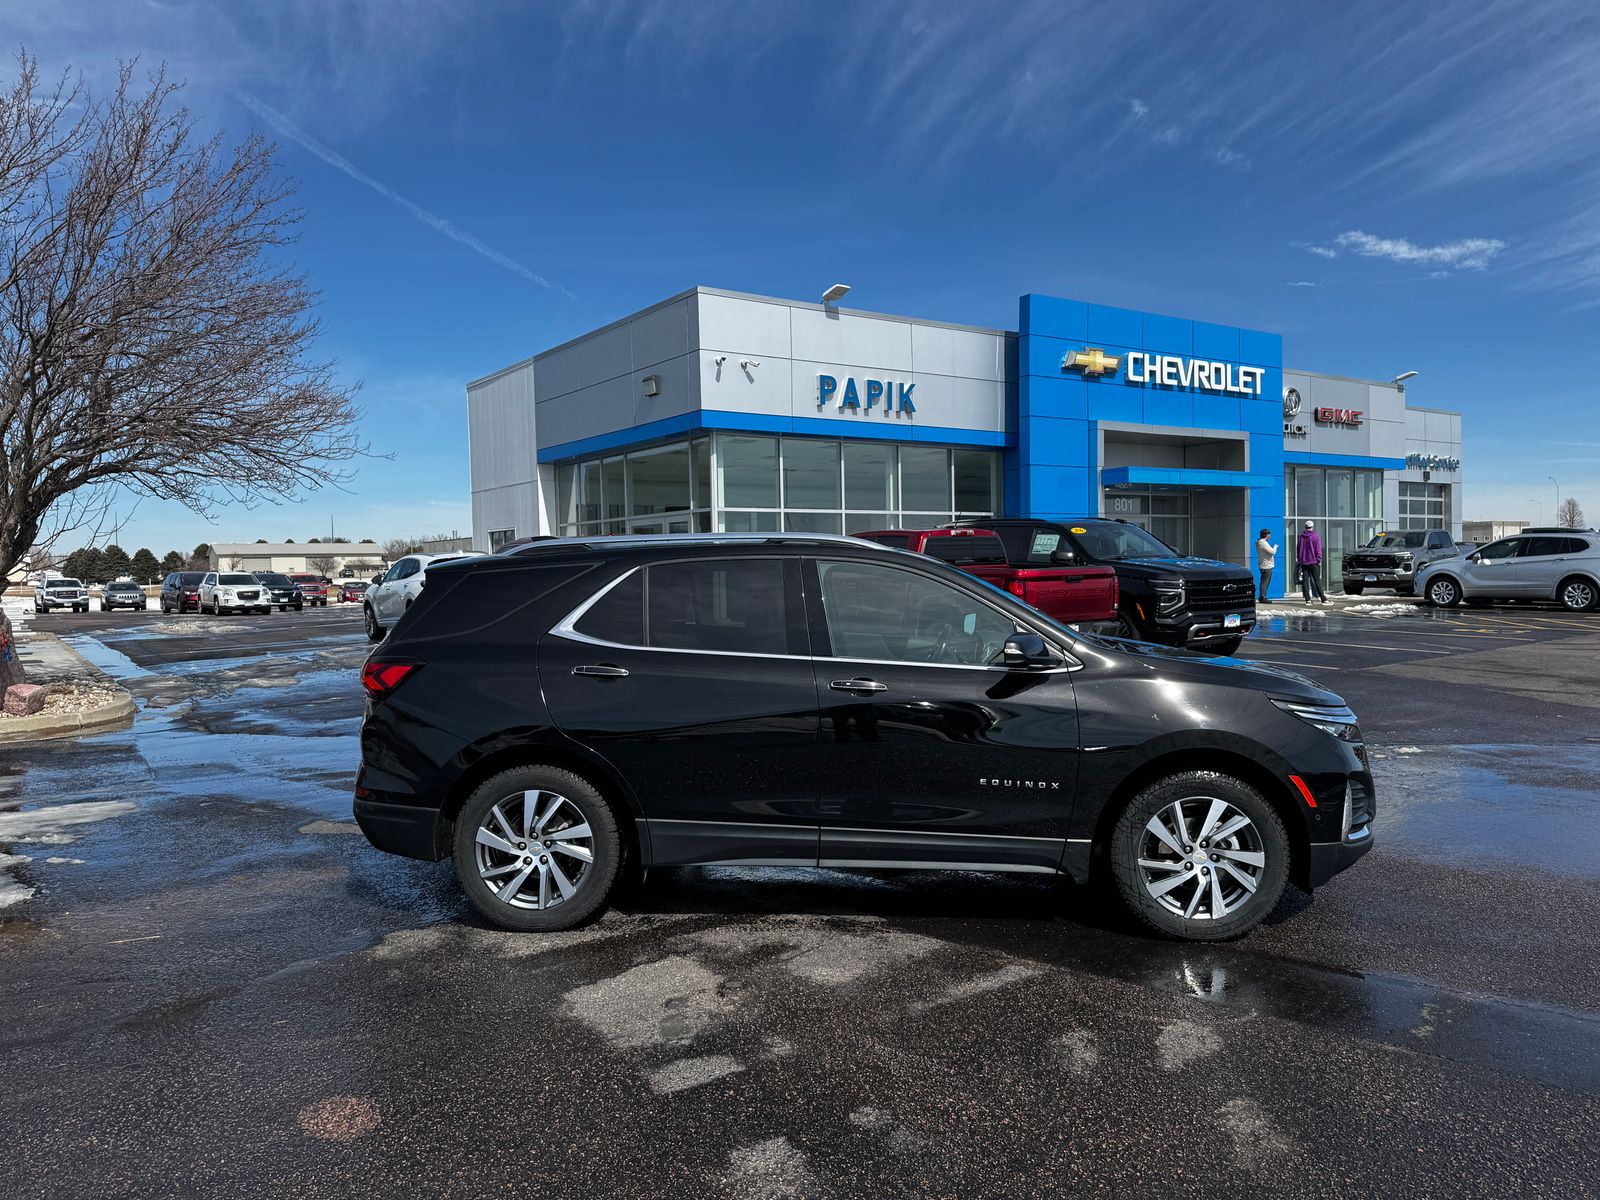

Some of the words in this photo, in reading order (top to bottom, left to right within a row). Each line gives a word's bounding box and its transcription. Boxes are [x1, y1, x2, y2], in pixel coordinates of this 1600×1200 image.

[1127, 352, 1265, 395] CHEVROLET
[816, 374, 917, 413] PAPIK
[1316, 407, 1363, 425] GMC
[1283, 423, 1309, 434] UICK
[1430, 455, 1460, 470] Service
[1114, 498, 1133, 511] 801
[979, 778, 1060, 789] EQUINOX
